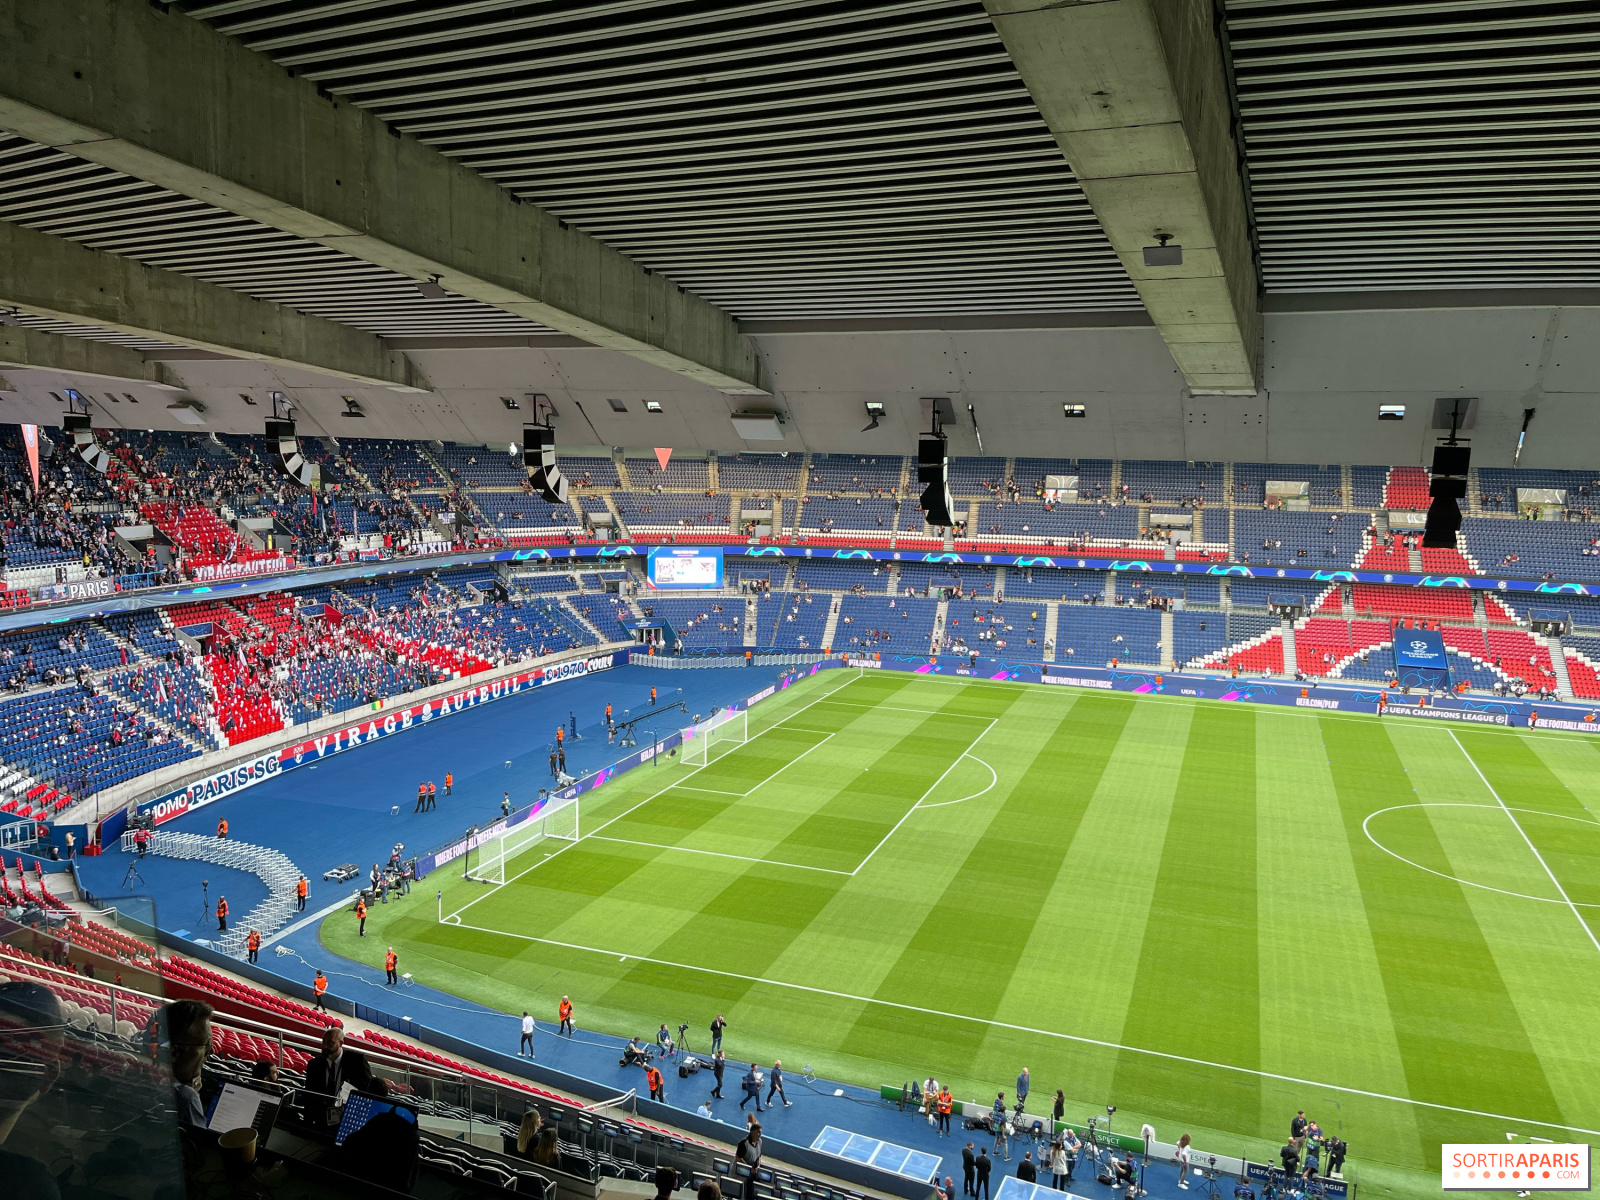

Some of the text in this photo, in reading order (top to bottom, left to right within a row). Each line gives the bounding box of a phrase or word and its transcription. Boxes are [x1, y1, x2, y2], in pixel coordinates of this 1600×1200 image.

[70, 580, 109, 598] PARIS
[557, 661, 585, 679] 1970
[1180, 688, 1197, 696] UEFA
[314, 676, 521, 757] VIRAGE AUTEUIL
[1389, 706, 1494, 722] UEFA CHAMPIONS LEAGUE
[564, 787, 577, 799] UEFA
[434, 847, 454, 868] WHERE
[1250, 1167, 1270, 1177] UEFA
